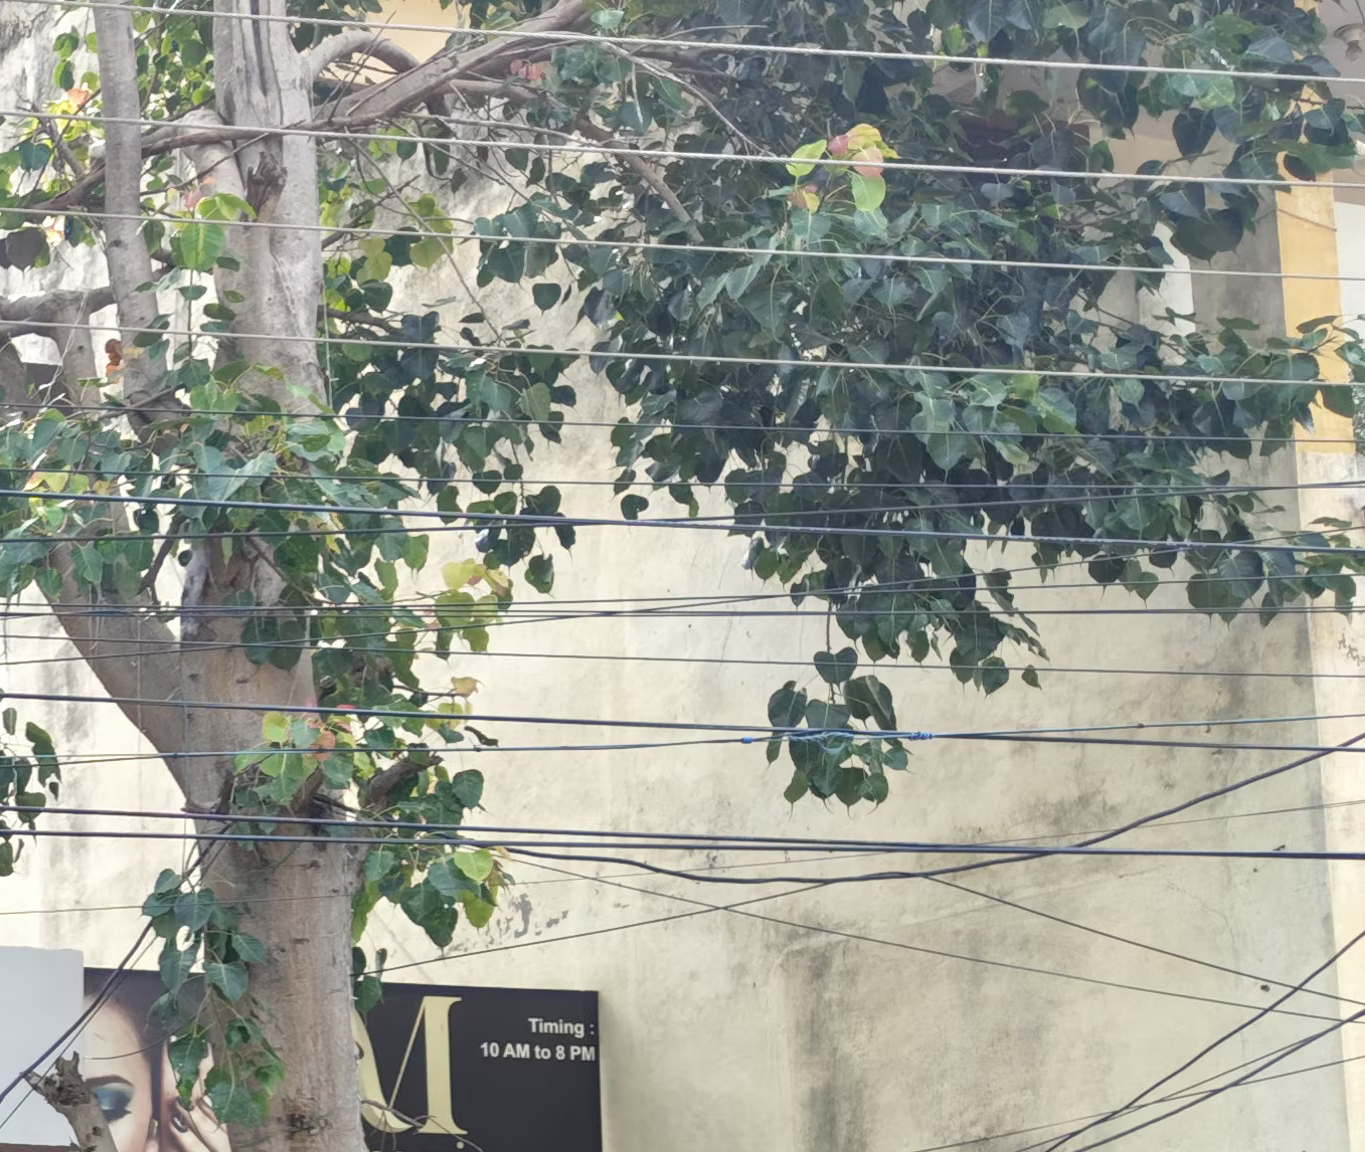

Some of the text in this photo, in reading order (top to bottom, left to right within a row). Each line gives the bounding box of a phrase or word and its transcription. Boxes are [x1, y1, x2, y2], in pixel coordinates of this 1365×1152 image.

[528, 1018, 585, 1038] Timing
[480, 1042, 596, 1061] 10 AM to 8 PM
